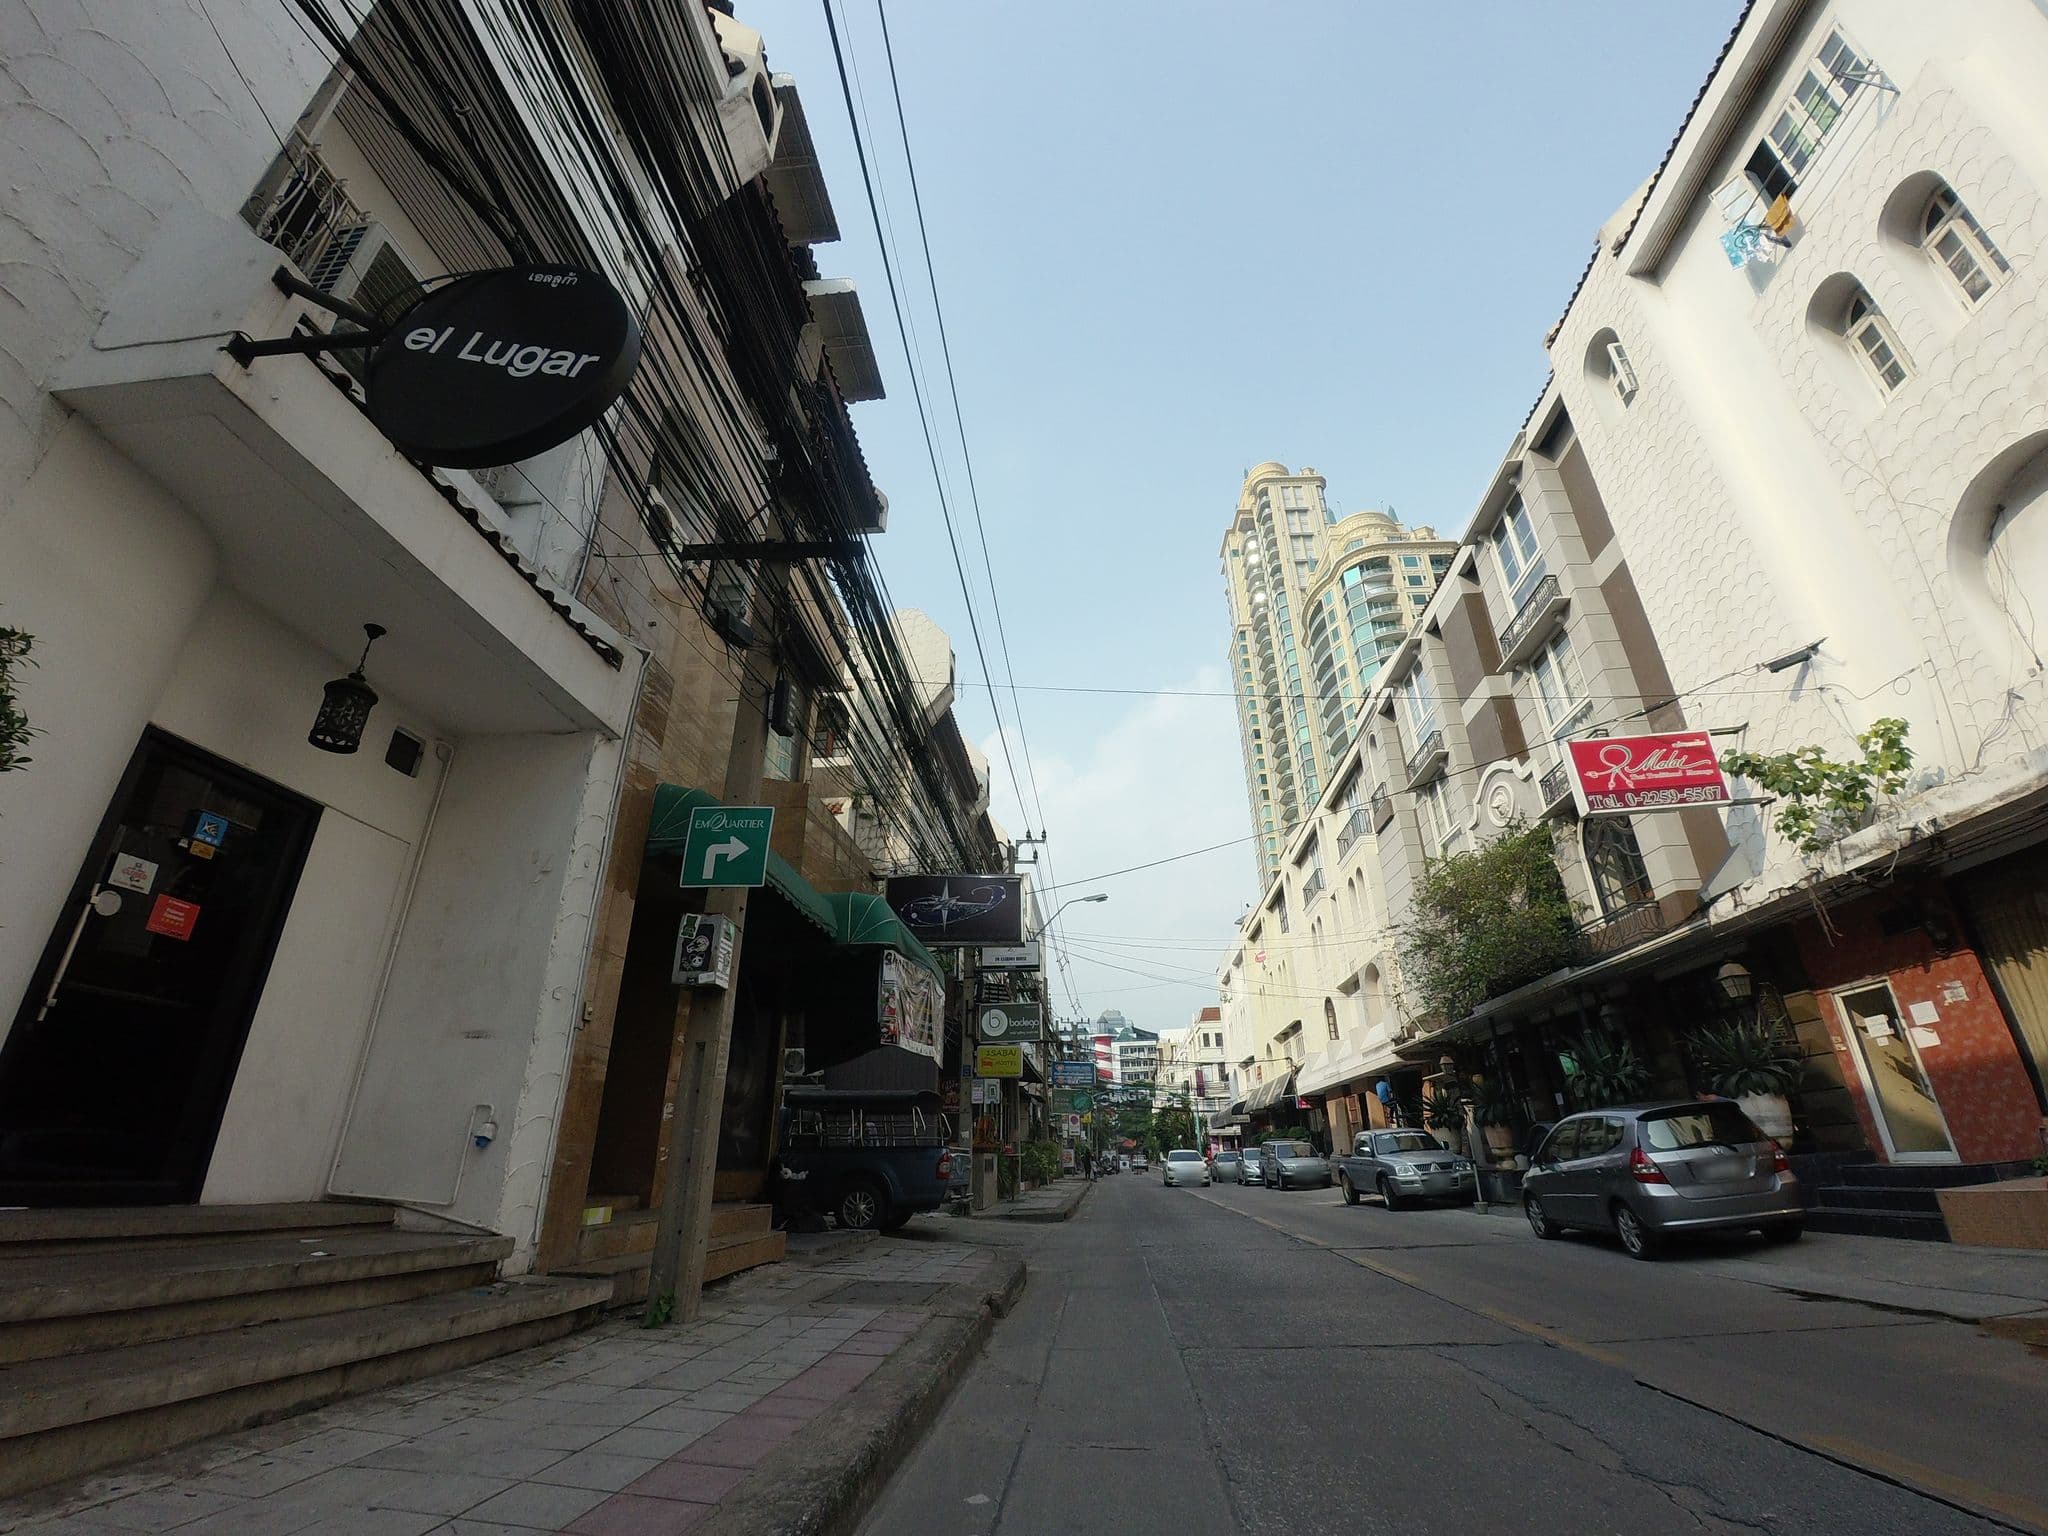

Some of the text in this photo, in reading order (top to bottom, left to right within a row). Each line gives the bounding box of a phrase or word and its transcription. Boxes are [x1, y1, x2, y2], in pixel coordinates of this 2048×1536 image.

[404, 326, 600, 378] el Lugar
[1626, 748, 1711, 774] Malai
[1588, 785, 1721, 810] Tel. 0-2259-5567
[695, 811, 764, 832] EMQUARTIER
